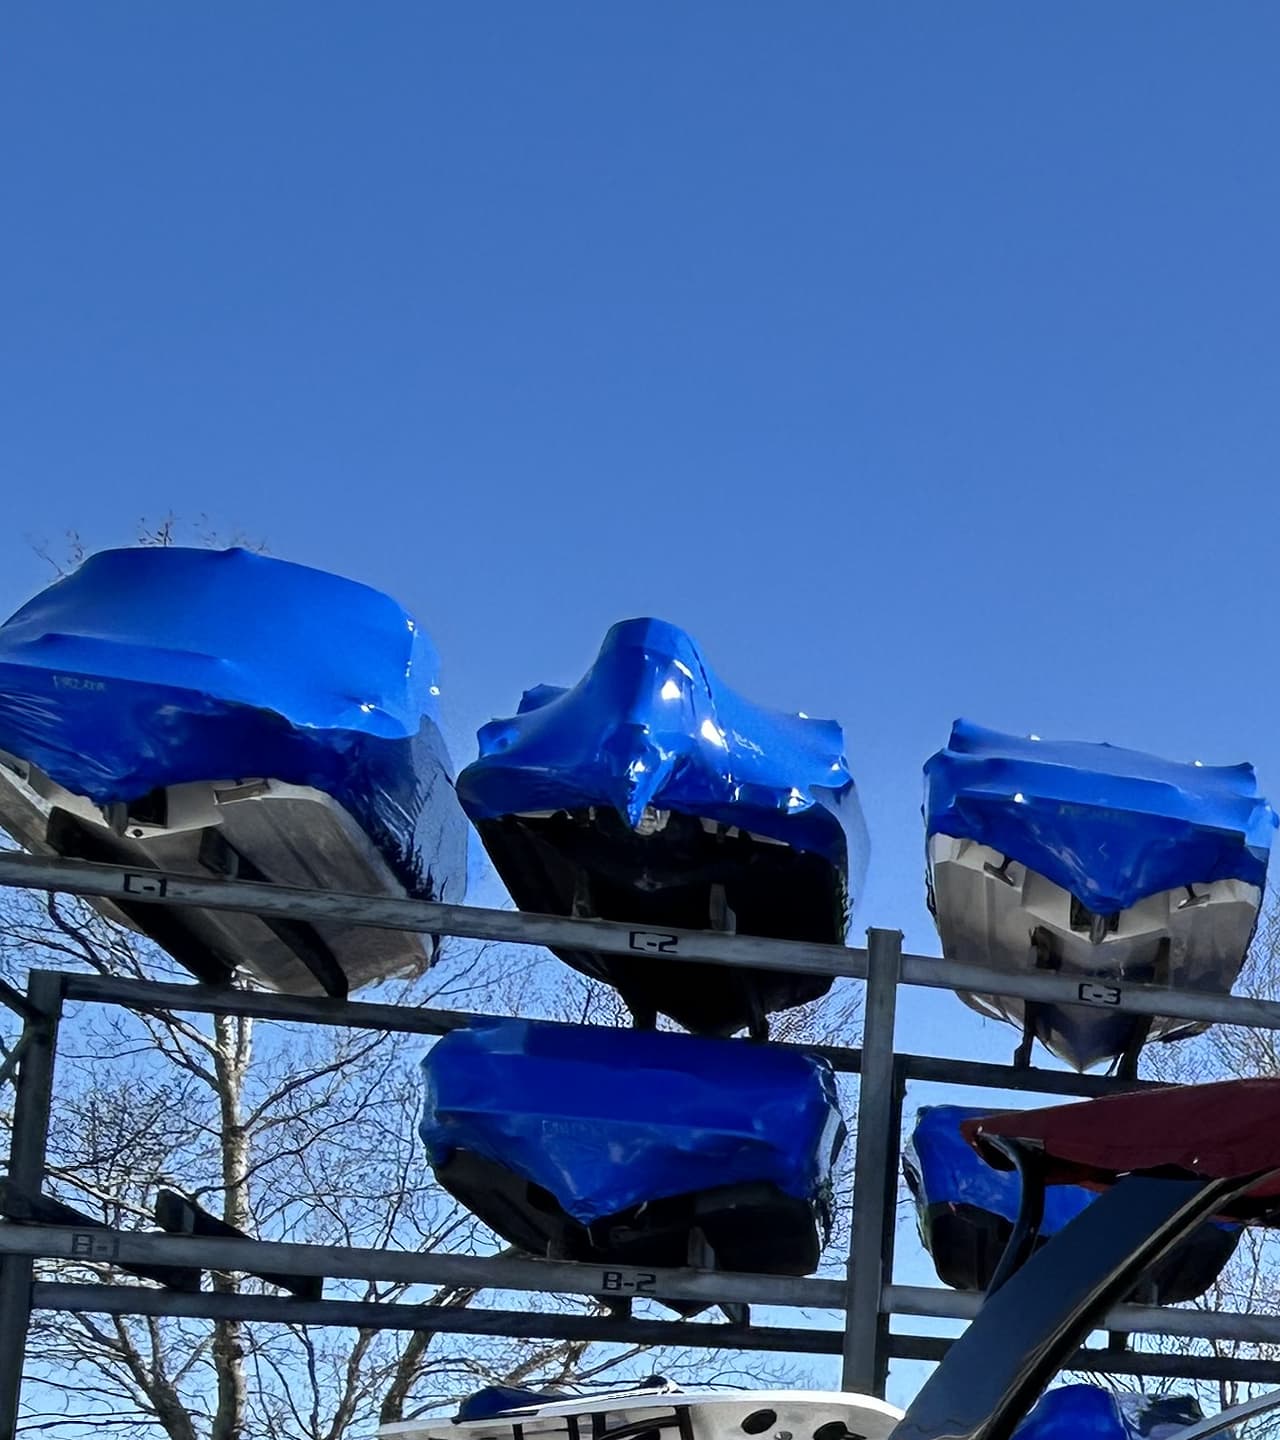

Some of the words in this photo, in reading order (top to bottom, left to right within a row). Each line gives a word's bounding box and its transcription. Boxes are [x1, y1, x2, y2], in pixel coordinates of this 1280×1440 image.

[124, 873, 167, 899] C-1
[628, 930, 679, 954] C-2
[1078, 982, 1121, 1006] C-3
[72, 1233, 120, 1259] B-1
[601, 1270, 657, 1294] B-2
